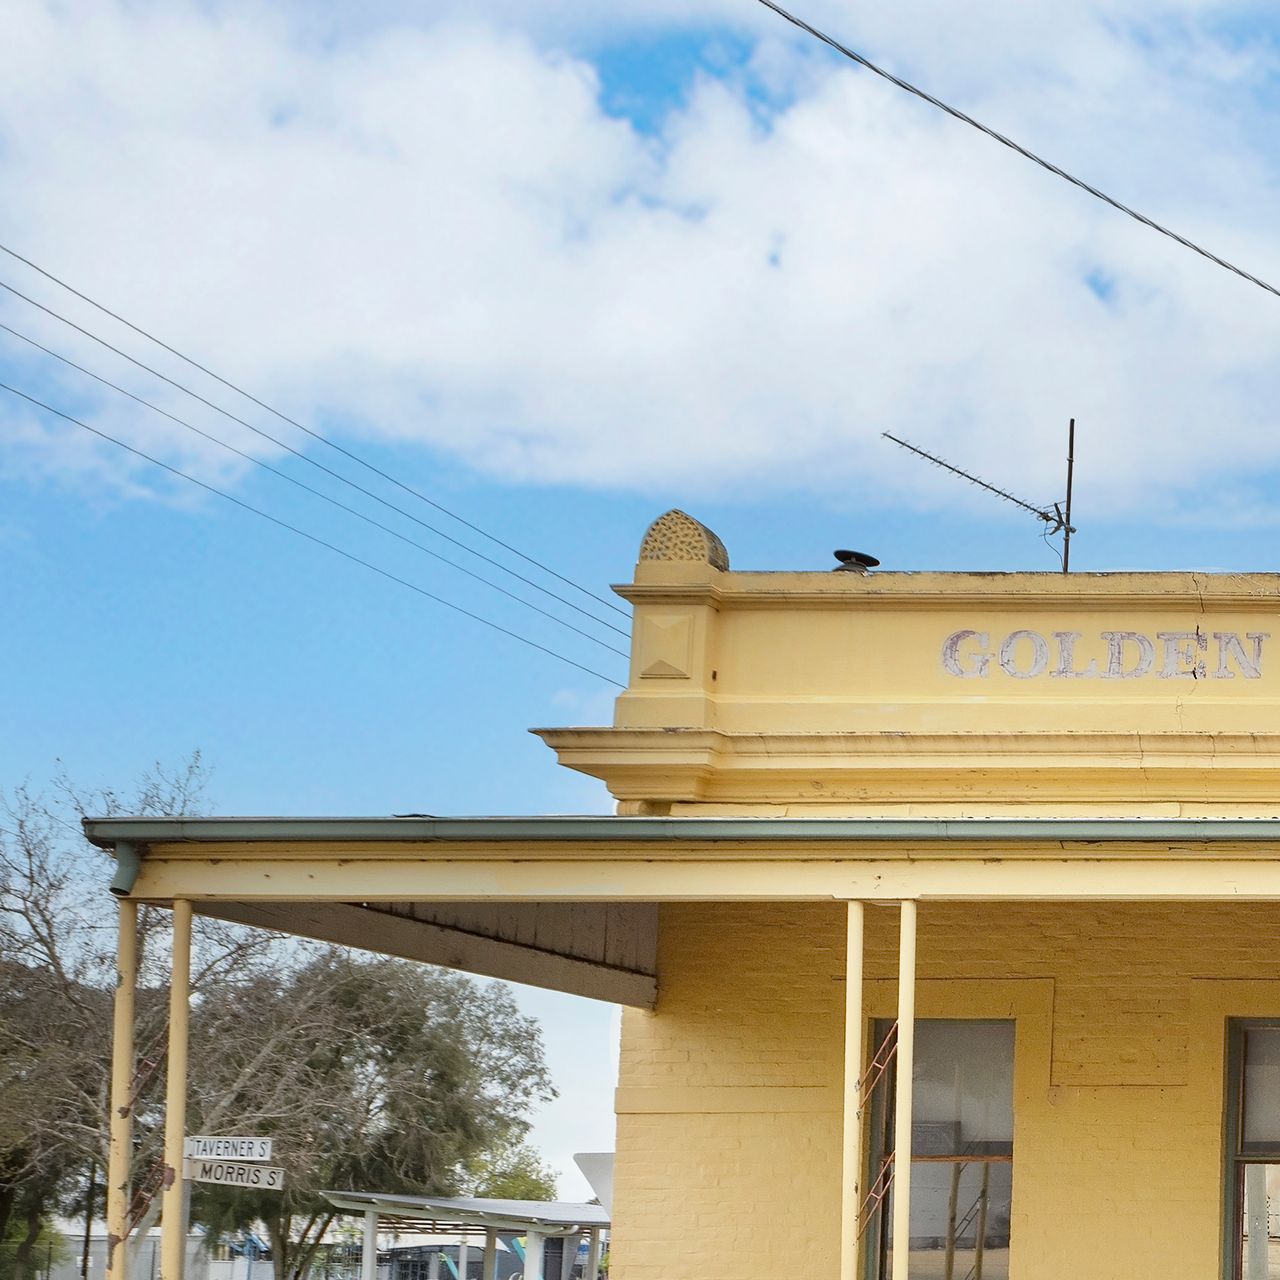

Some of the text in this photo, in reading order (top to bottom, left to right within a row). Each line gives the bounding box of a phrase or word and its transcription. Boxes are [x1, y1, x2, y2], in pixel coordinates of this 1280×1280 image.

[942, 629, 1271, 679] GOLDEN
[196, 1140, 255, 1157] TAVERNER
[200, 1163, 261, 1184] MORRIS
